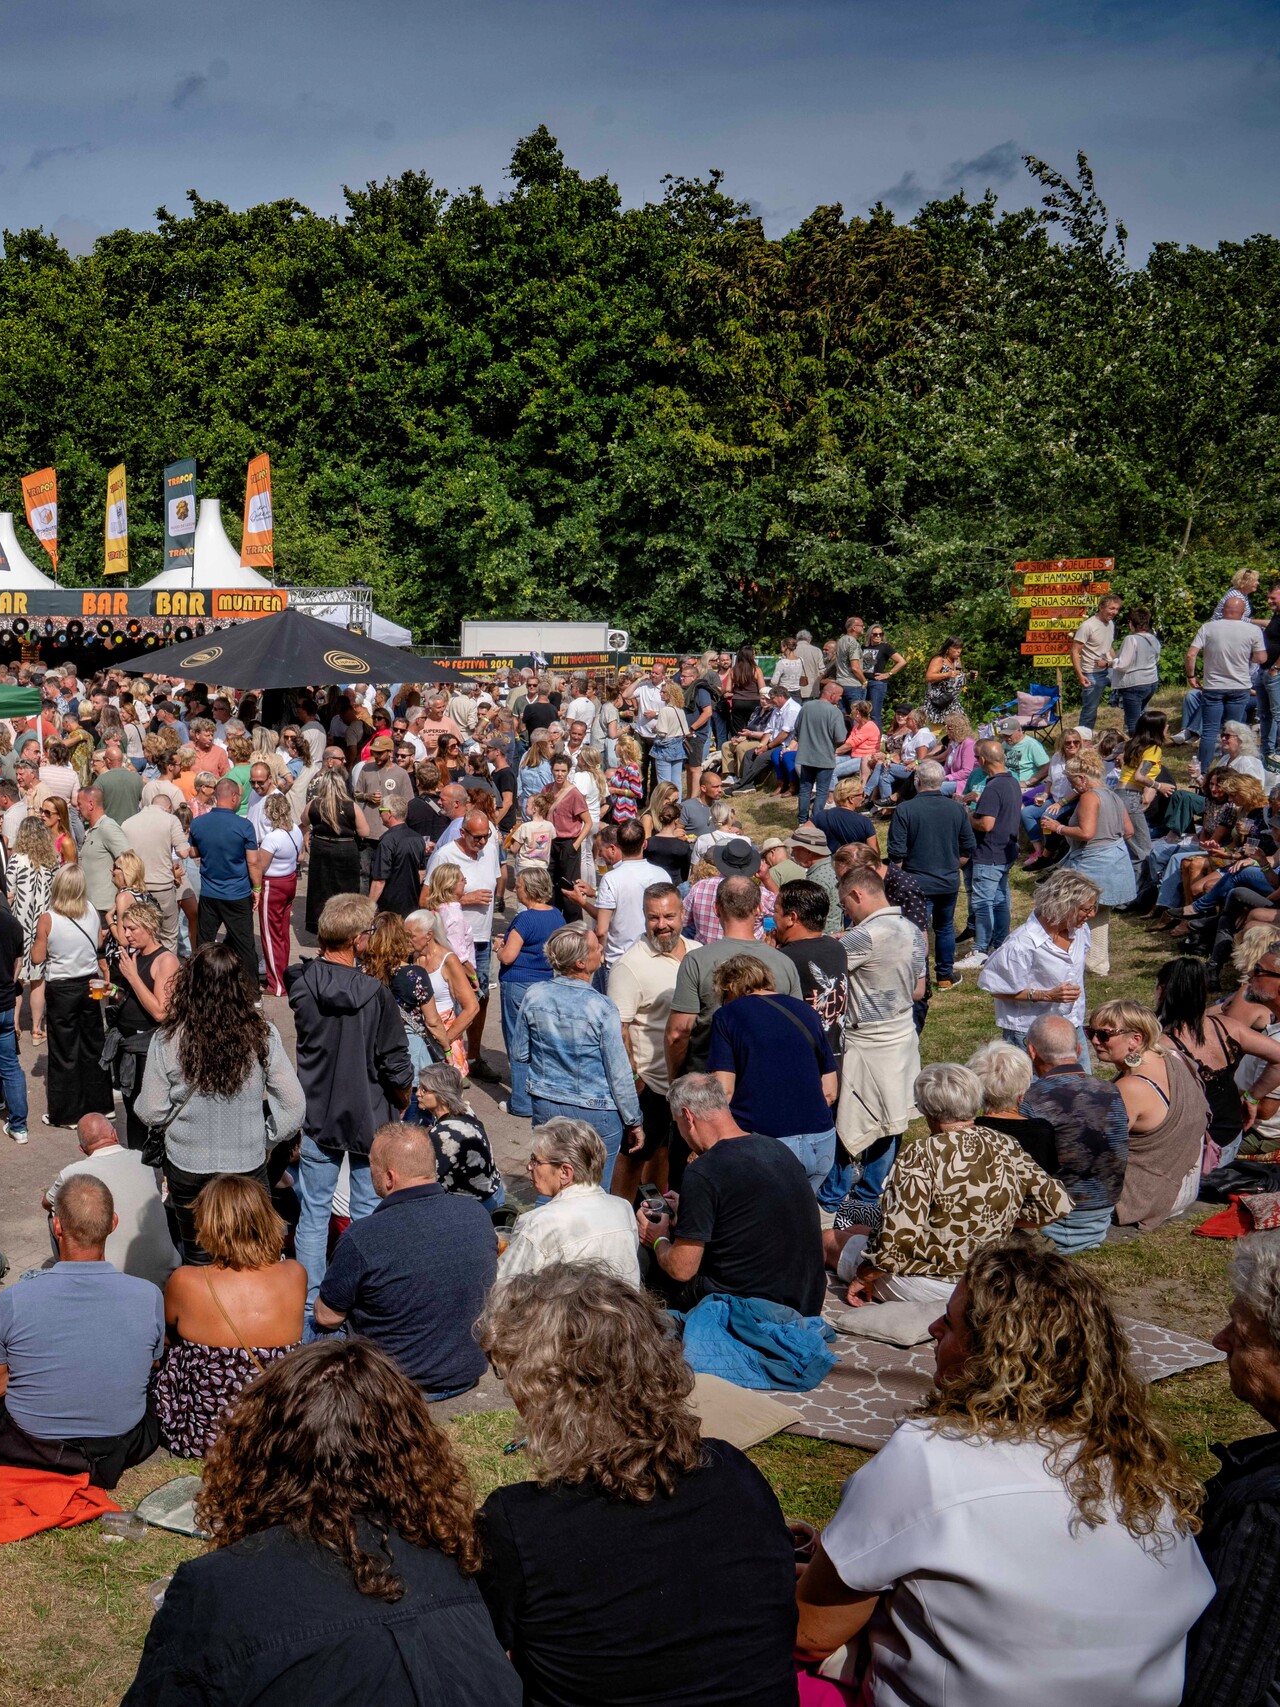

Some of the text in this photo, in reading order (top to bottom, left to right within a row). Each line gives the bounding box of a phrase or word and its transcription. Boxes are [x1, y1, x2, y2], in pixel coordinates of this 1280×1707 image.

[167, 473, 194, 487] TRAPOP
[27, 481, 54, 497] TRAPOP
[107, 549, 128, 561] TRAPO
[168, 547, 195, 557] TRAPO
[245, 544, 273, 555] TRAPO
[1068, 559, 1105, 570] JEWELS
[82, 592, 128, 615] BAR
[155, 592, 283, 615] BAR MUNTEN
[1030, 597, 1059, 607] SENJA
[452, 660, 488, 669] FESTIVAL
[490, 660, 513, 669] 2024
[631, 656, 641, 665] DIT
